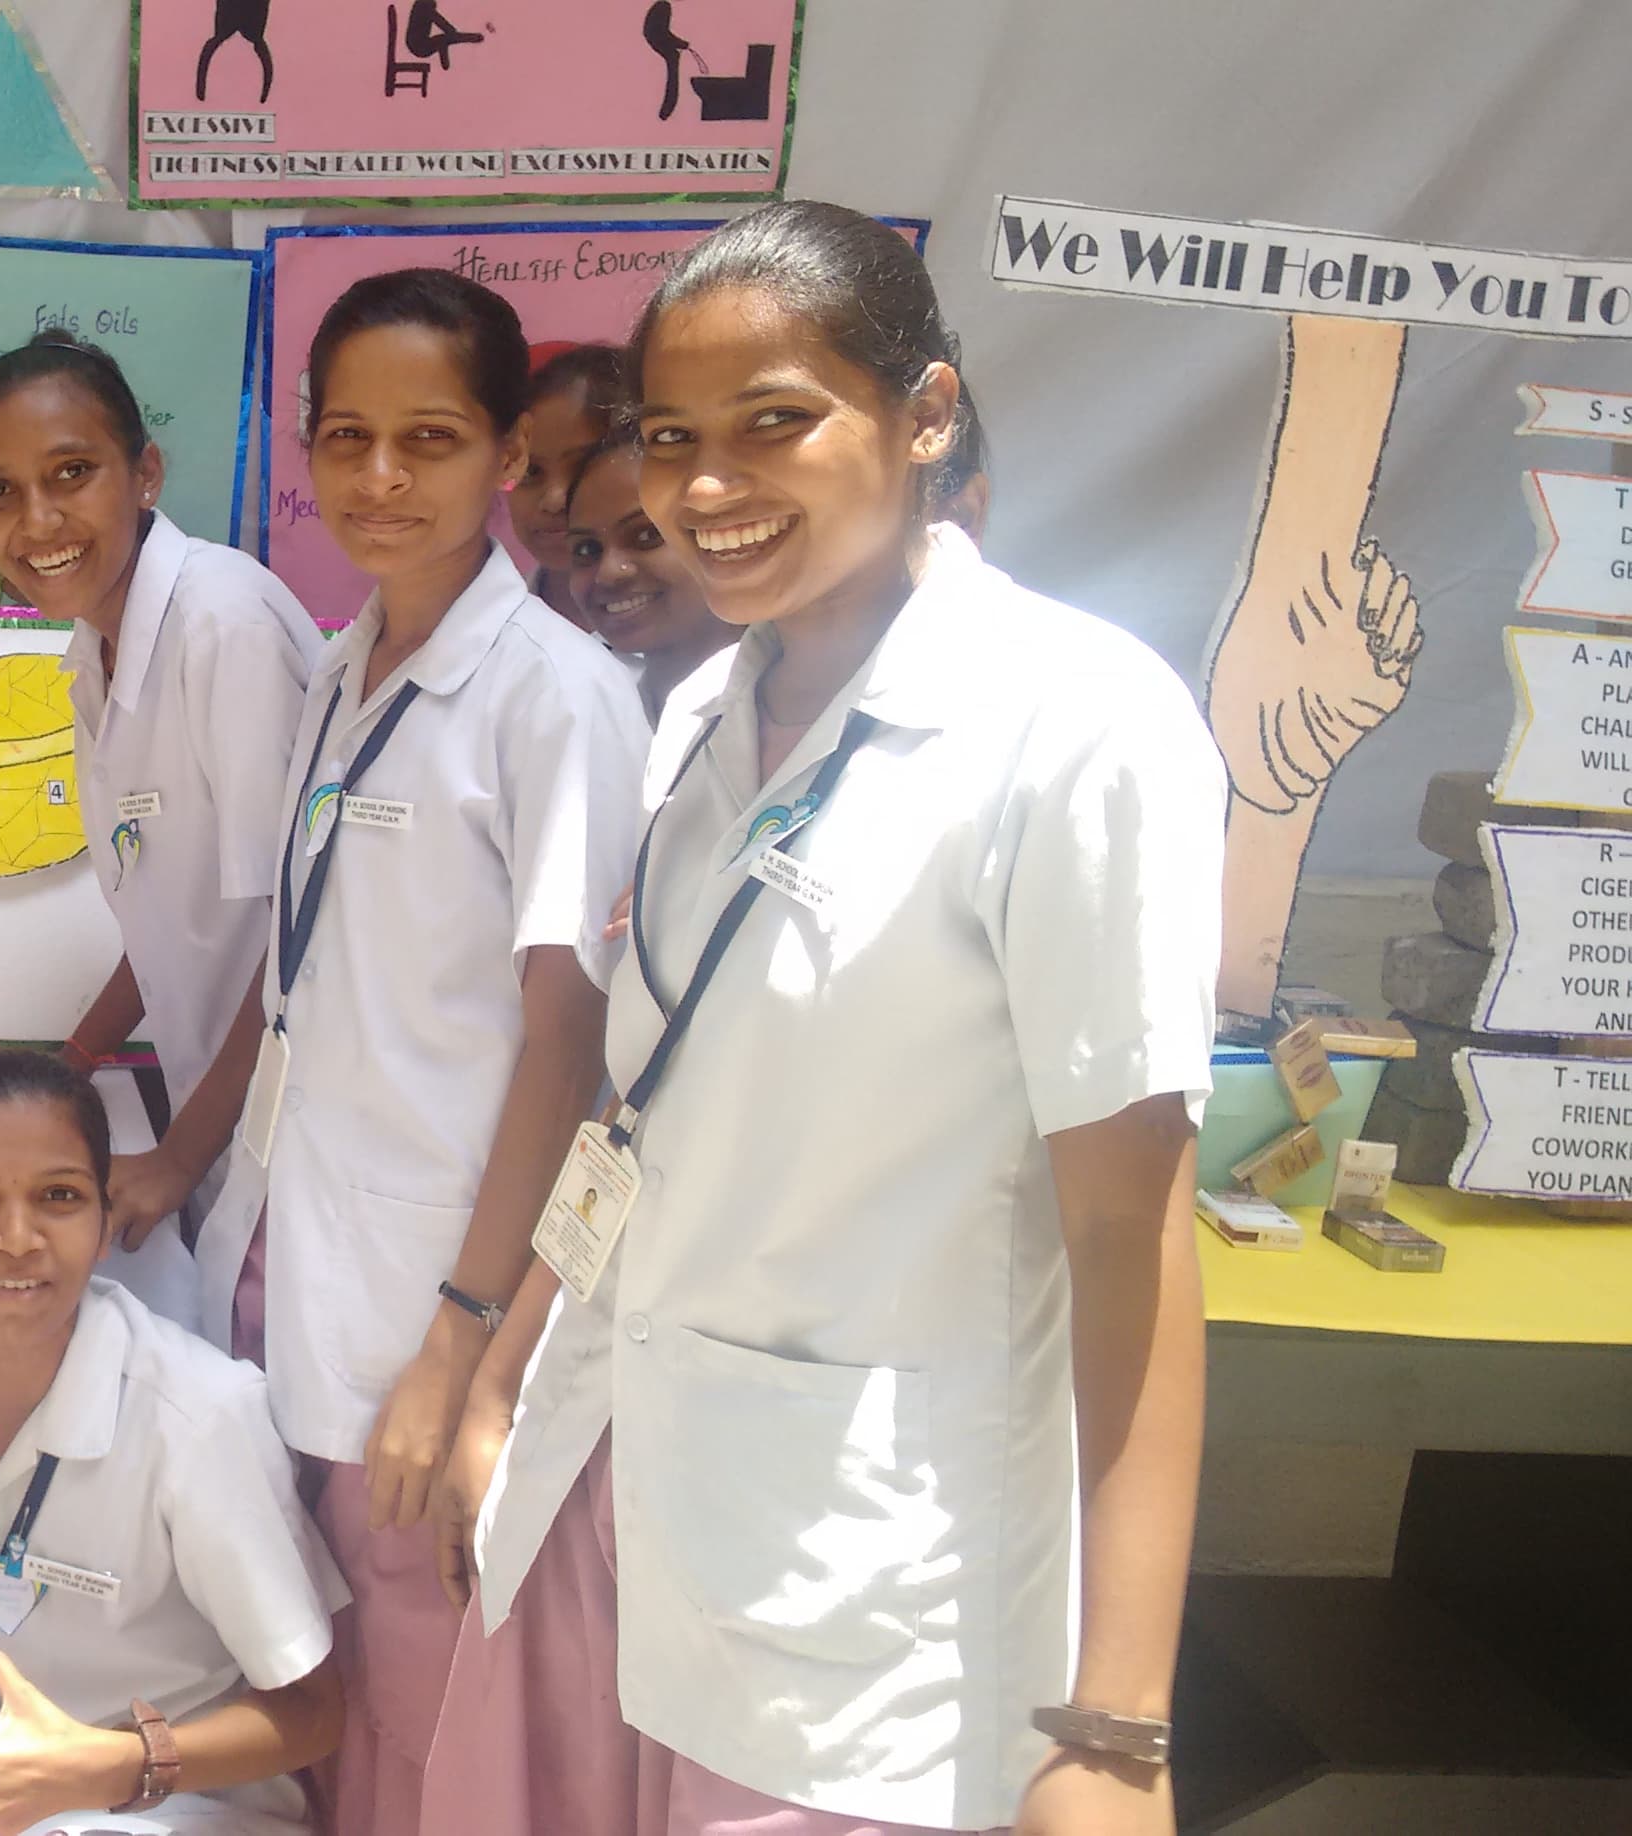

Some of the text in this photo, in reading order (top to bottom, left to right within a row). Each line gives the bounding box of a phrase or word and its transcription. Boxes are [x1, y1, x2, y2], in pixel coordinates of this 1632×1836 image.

[147, 116, 268, 134] EXCESSIVE
[154, 155, 279, 173] TIGHTNESS
[287, 154, 503, 172] UNHEALED WOUND
[511, 152, 772, 171] EXCESSIVE URINATION
[1003, 215, 1631, 326] We Will Help You To
[96, 305, 138, 335] Oils
[1589, 400, 1603, 422] S
[1615, 487, 1629, 509] T
[1571, 643, 1590, 665] A
[1581, 750, 1631, 772] WILL
[51, 784, 62, 799] 4
[1600, 843, 1613, 862] R
[1561, 976, 1620, 998] YOUR
[1554, 1066, 1568, 1088] T
[1532, 1137, 1632, 1160] COWORK
[1528, 1171, 1632, 1194] YOU PLAN
